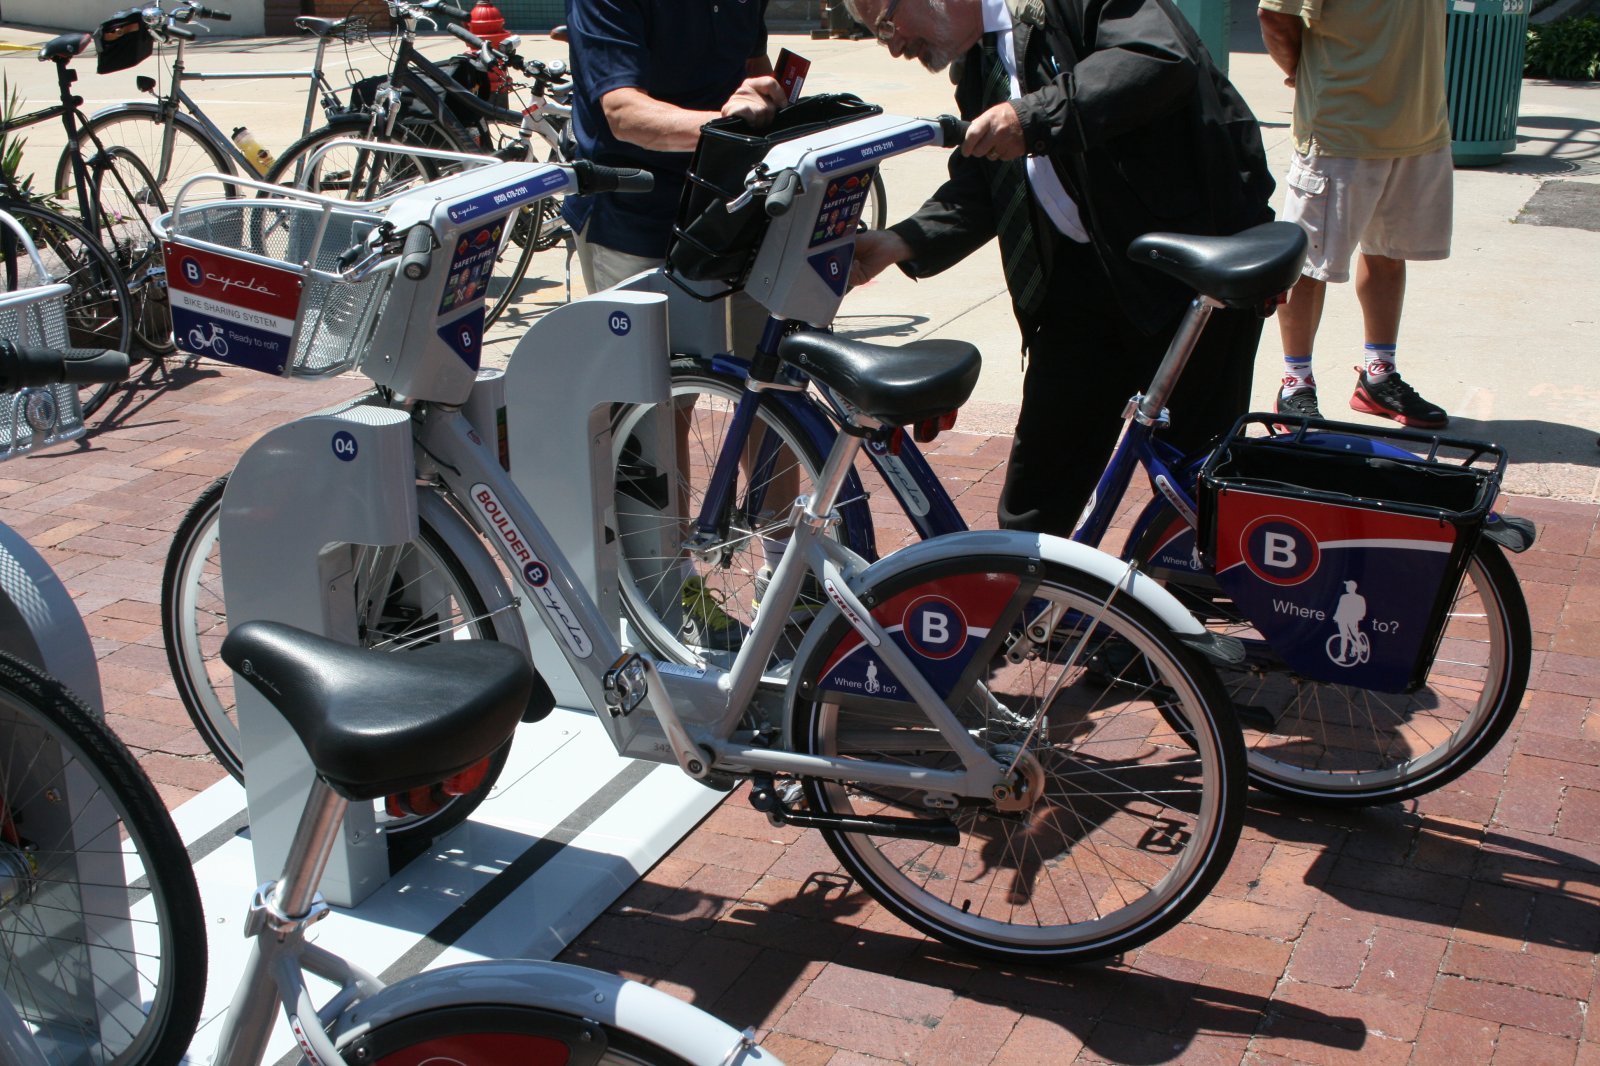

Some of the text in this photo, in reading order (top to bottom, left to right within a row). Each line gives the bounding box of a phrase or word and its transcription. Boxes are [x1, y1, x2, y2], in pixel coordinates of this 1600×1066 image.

[823, 191, 864, 210] SAFETY FIRST
[453, 246, 496, 270] SAFETY FIRST
[830, 262, 839, 276] B
[186, 263, 276, 296] B cycle
[183, 296, 278, 328] BIKE SHARING SYSTEM
[611, 316, 628, 330] 05
[229, 331, 279, 351] Ready to roll?
[461, 331, 472, 348] B
[335, 438, 355, 455] 04
[476, 490, 531, 562] BOULDER
[1162, 555, 1188, 566] Where
[1264, 531, 1297, 569] B
[528, 566, 584, 652] B cycle
[828, 583, 860, 623] TREK
[922, 610, 950, 644] B
[1272, 598, 1400, 635] Where to?
[834, 676, 897, 694] Where to?
